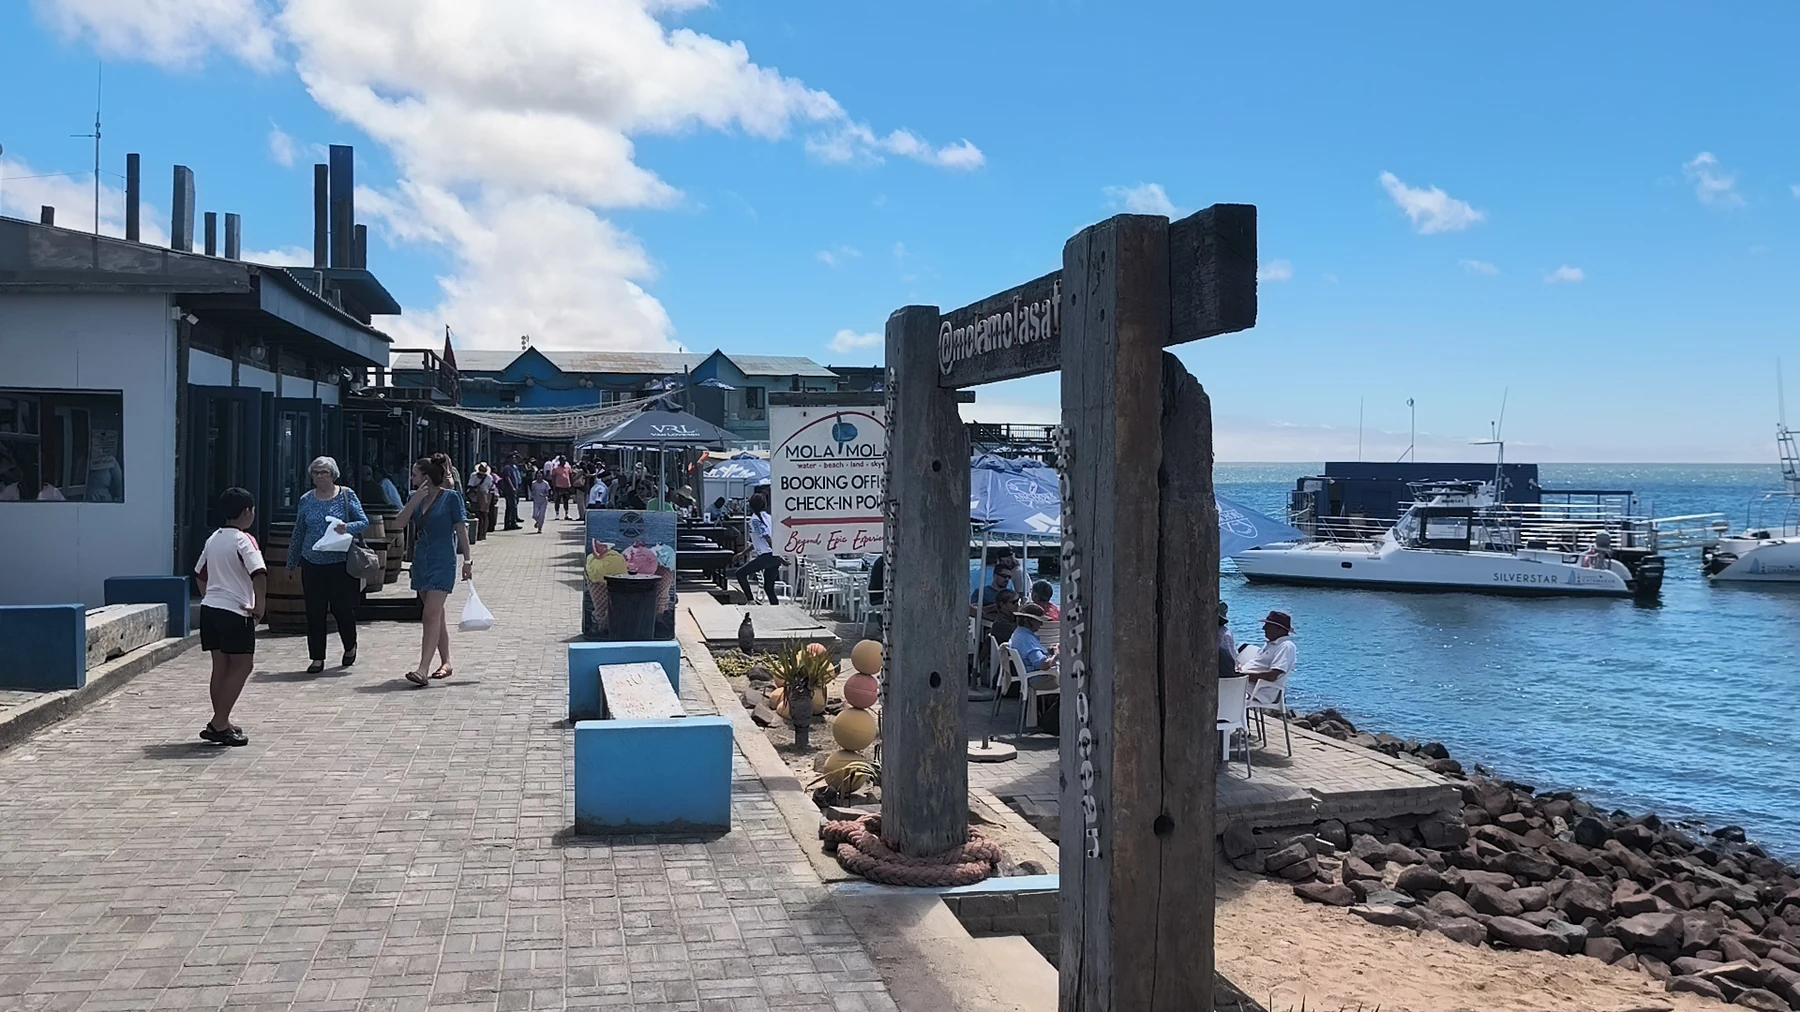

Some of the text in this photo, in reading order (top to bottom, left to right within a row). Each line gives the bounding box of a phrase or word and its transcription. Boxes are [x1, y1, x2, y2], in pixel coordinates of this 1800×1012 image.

[785, 443, 885, 459] MOLA MOL
[823, 461, 844, 469] beach
[780, 474, 881, 490] BOOKING OFFI
[784, 495, 881, 512] CHECK-IN POI
[784, 530, 822, 554] Beyond
[827, 530, 848, 551] Epic
[1493, 572, 1558, 584] SILVERSTAR
